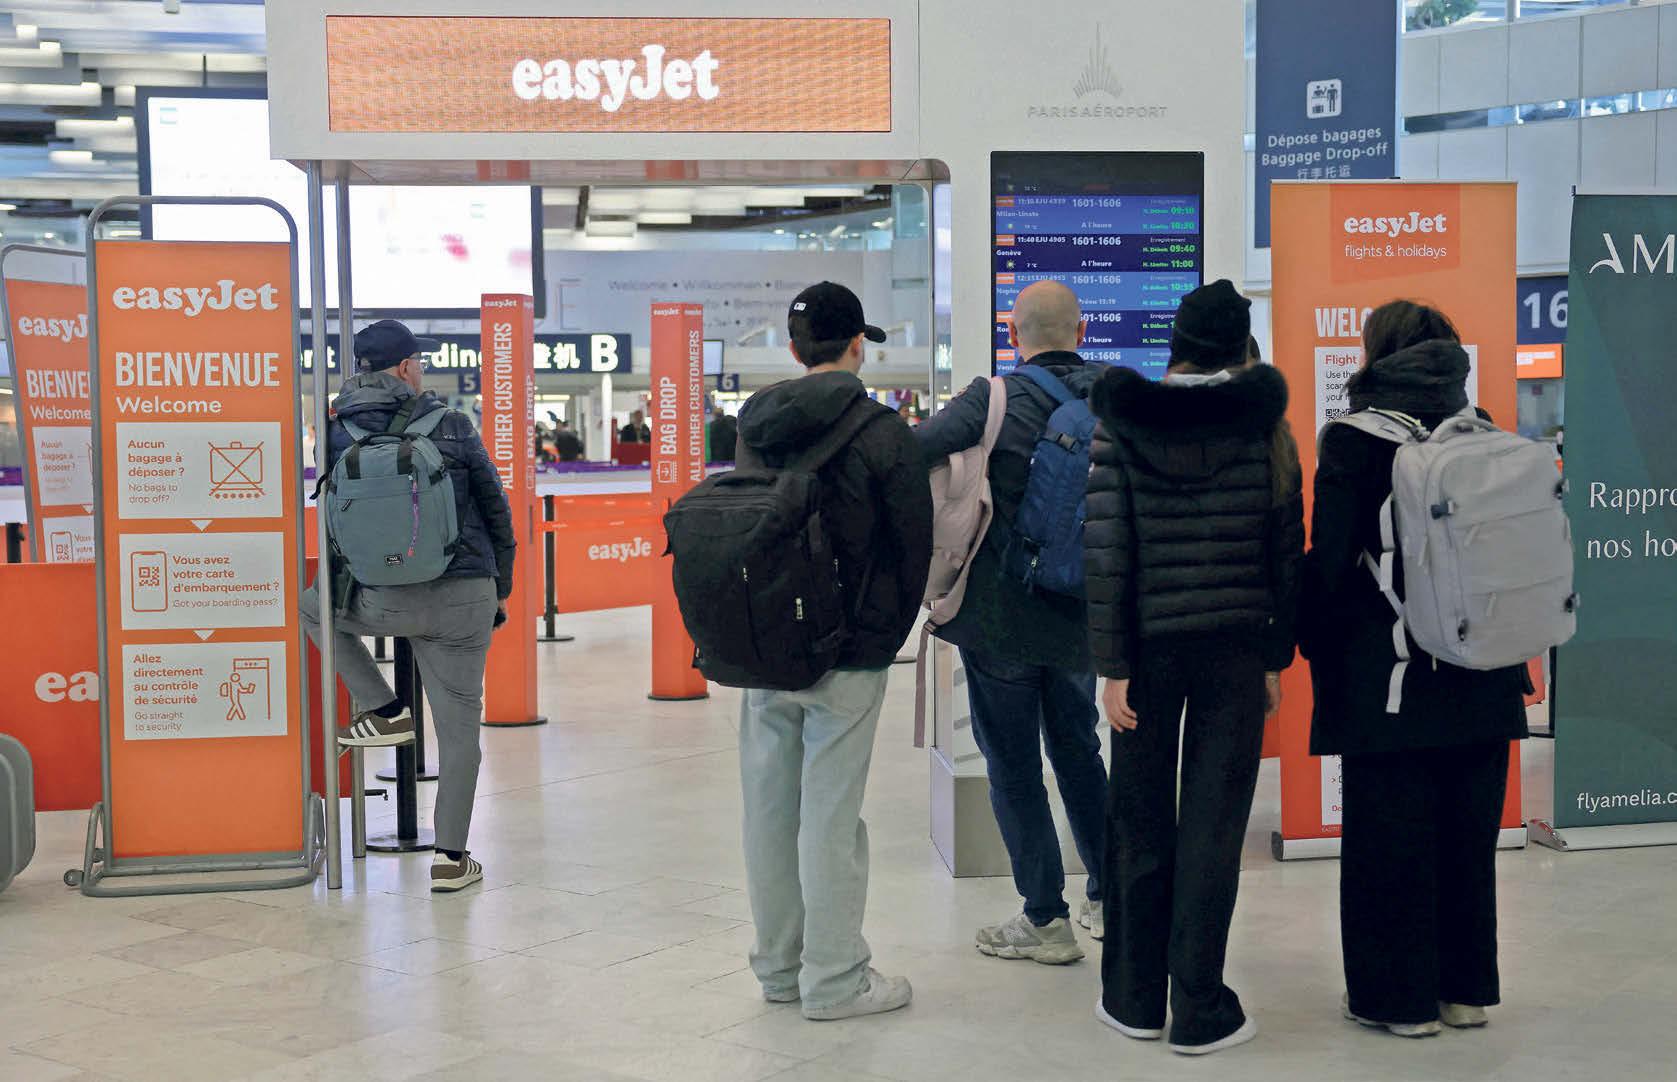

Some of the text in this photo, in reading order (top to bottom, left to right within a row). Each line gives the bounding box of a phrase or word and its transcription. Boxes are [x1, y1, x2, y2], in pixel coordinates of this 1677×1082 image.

[512, 44, 719, 112] easyJet
[1268, 127, 1382, 149] Dépose bagages
[1262, 143, 1388, 167] Baggage Drop-off
[1073, 198, 1121, 208] 1601-1606
[1344, 211, 1447, 238] easyJet
[1072, 237, 1121, 246] 1601-1606
[1345, 245, 1447, 259] flights & holidays
[1589, 233, 1675, 274] AM
[1073, 275, 1121, 284] 1601-1606
[112, 279, 279, 317] easyJet
[484, 299, 517, 308] easyJet
[1523, 290, 1568, 329] 16
[18, 314, 88, 343] easyJ
[591, 334, 619, 372] B
[1325, 354, 1357, 367] Flight
[115, 351, 280, 387] BIENVENUE
[688, 330, 700, 410] CUSTOMERS
[1326, 371, 1341, 379] Use
[26, 369, 90, 399] BIENVE
[464, 374, 476, 391] 5
[722, 377, 733, 390] 6
[116, 396, 222, 414] Welcome
[493, 322, 513, 490] ALL OTHER CUSTOMERS
[30, 405, 91, 421] Welcome
[660, 377, 678, 455] BAG DROP
[689, 413, 701, 456] OTHER
[127, 439, 165, 449] Aucun
[128, 451, 183, 465] bagage à
[128, 466, 185, 480] déposer ?
[690, 458, 702, 482] ALL
[128, 483, 178, 495] No bags to
[588, 537, 651, 562] easyJe
[1587, 539, 1632, 559] nos
[172, 555, 230, 566] Vous avez
[172, 569, 235, 579] votre carte
[173, 582, 280, 594] d'embarquement ?
[172, 598, 279, 610] Got your boarding pass?
[133, 654, 162, 664] Allez
[134, 667, 203, 677] directement
[34, 671, 99, 703] ea
[134, 680, 199, 691] au contrôle
[134, 694, 198, 705] de sécurité
[134, 711, 183, 722] Go straight
[136, 722, 182, 733] to security
